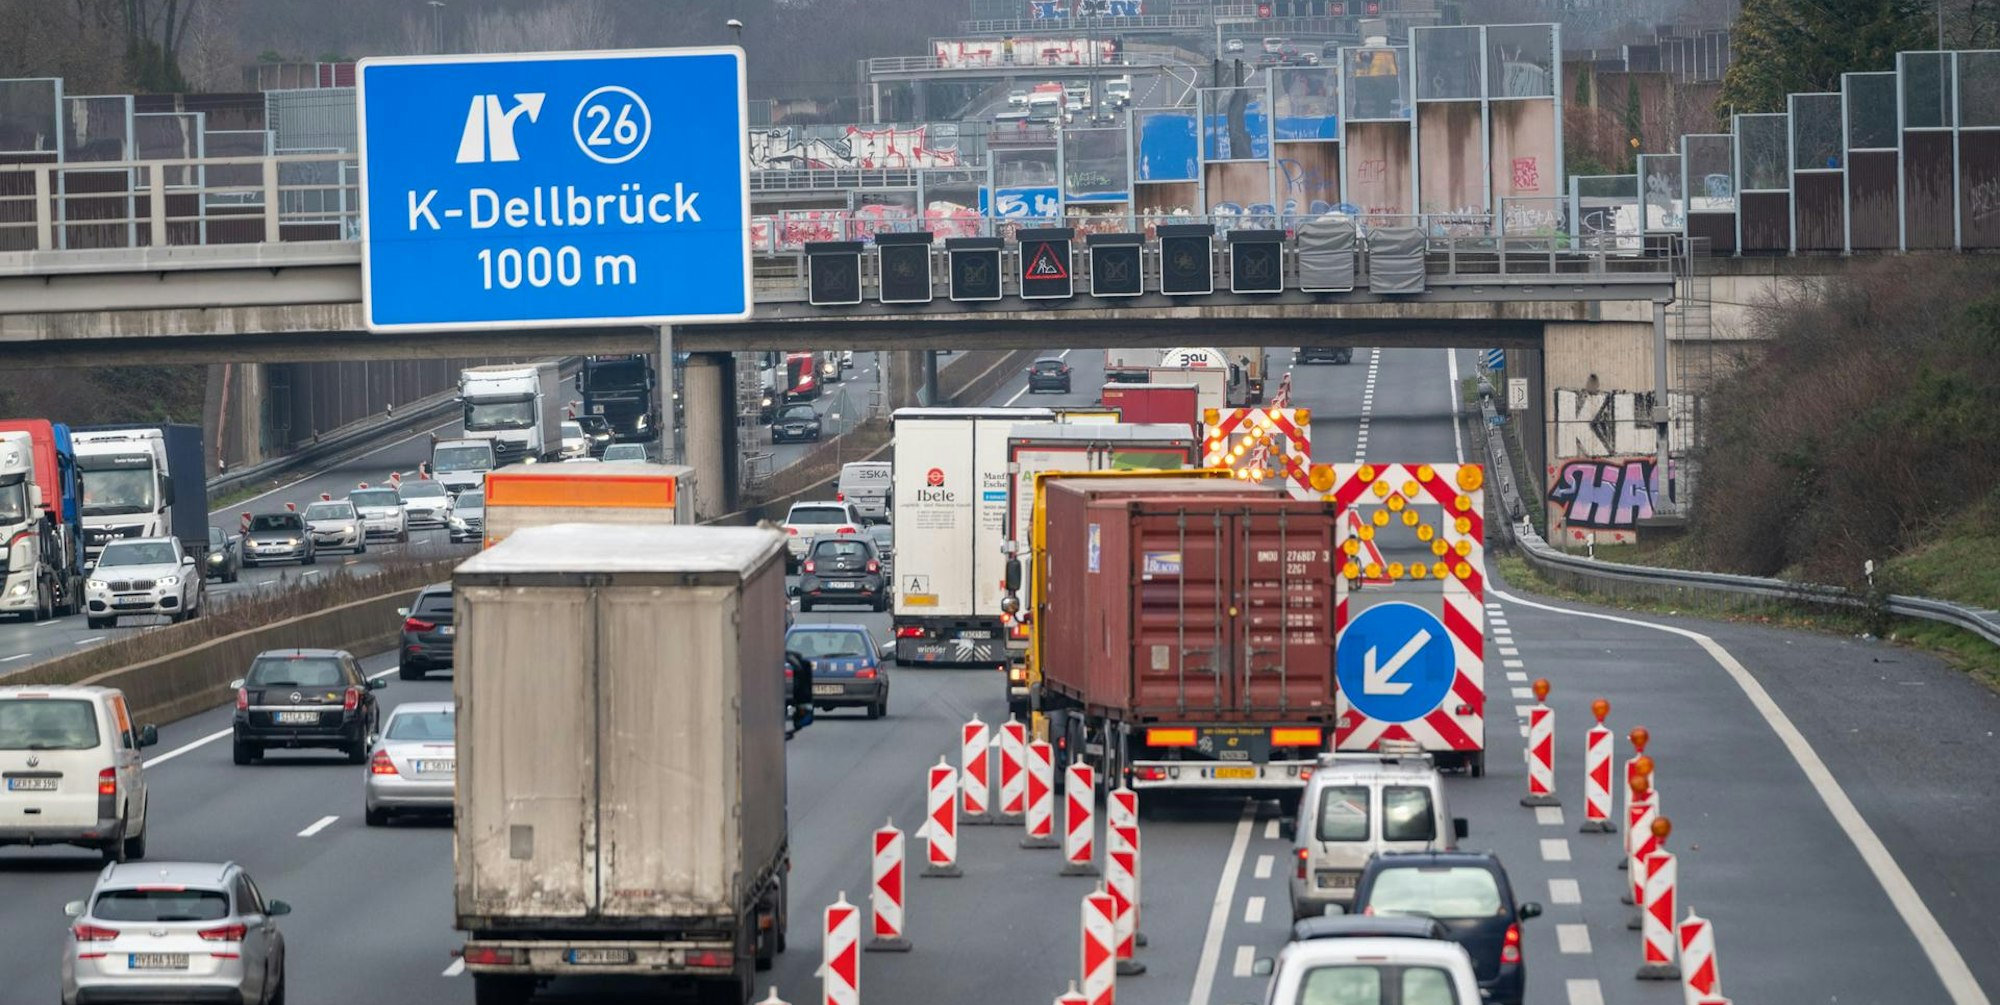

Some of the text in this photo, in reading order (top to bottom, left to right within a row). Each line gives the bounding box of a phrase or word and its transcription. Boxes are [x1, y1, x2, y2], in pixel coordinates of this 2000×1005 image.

[587, 105, 637, 146] 26
[408, 182, 701, 231] K-Dellbrück
[478, 245, 637, 290] 1000 m
[859, 470, 889, 479] ESKA
[917, 489, 955, 501] Ibele
[93, 534, 125, 542] MAN
[1322, 551, 1330, 562] 3
[910, 577, 922, 592] A
[917, 645, 946, 655] winkler
